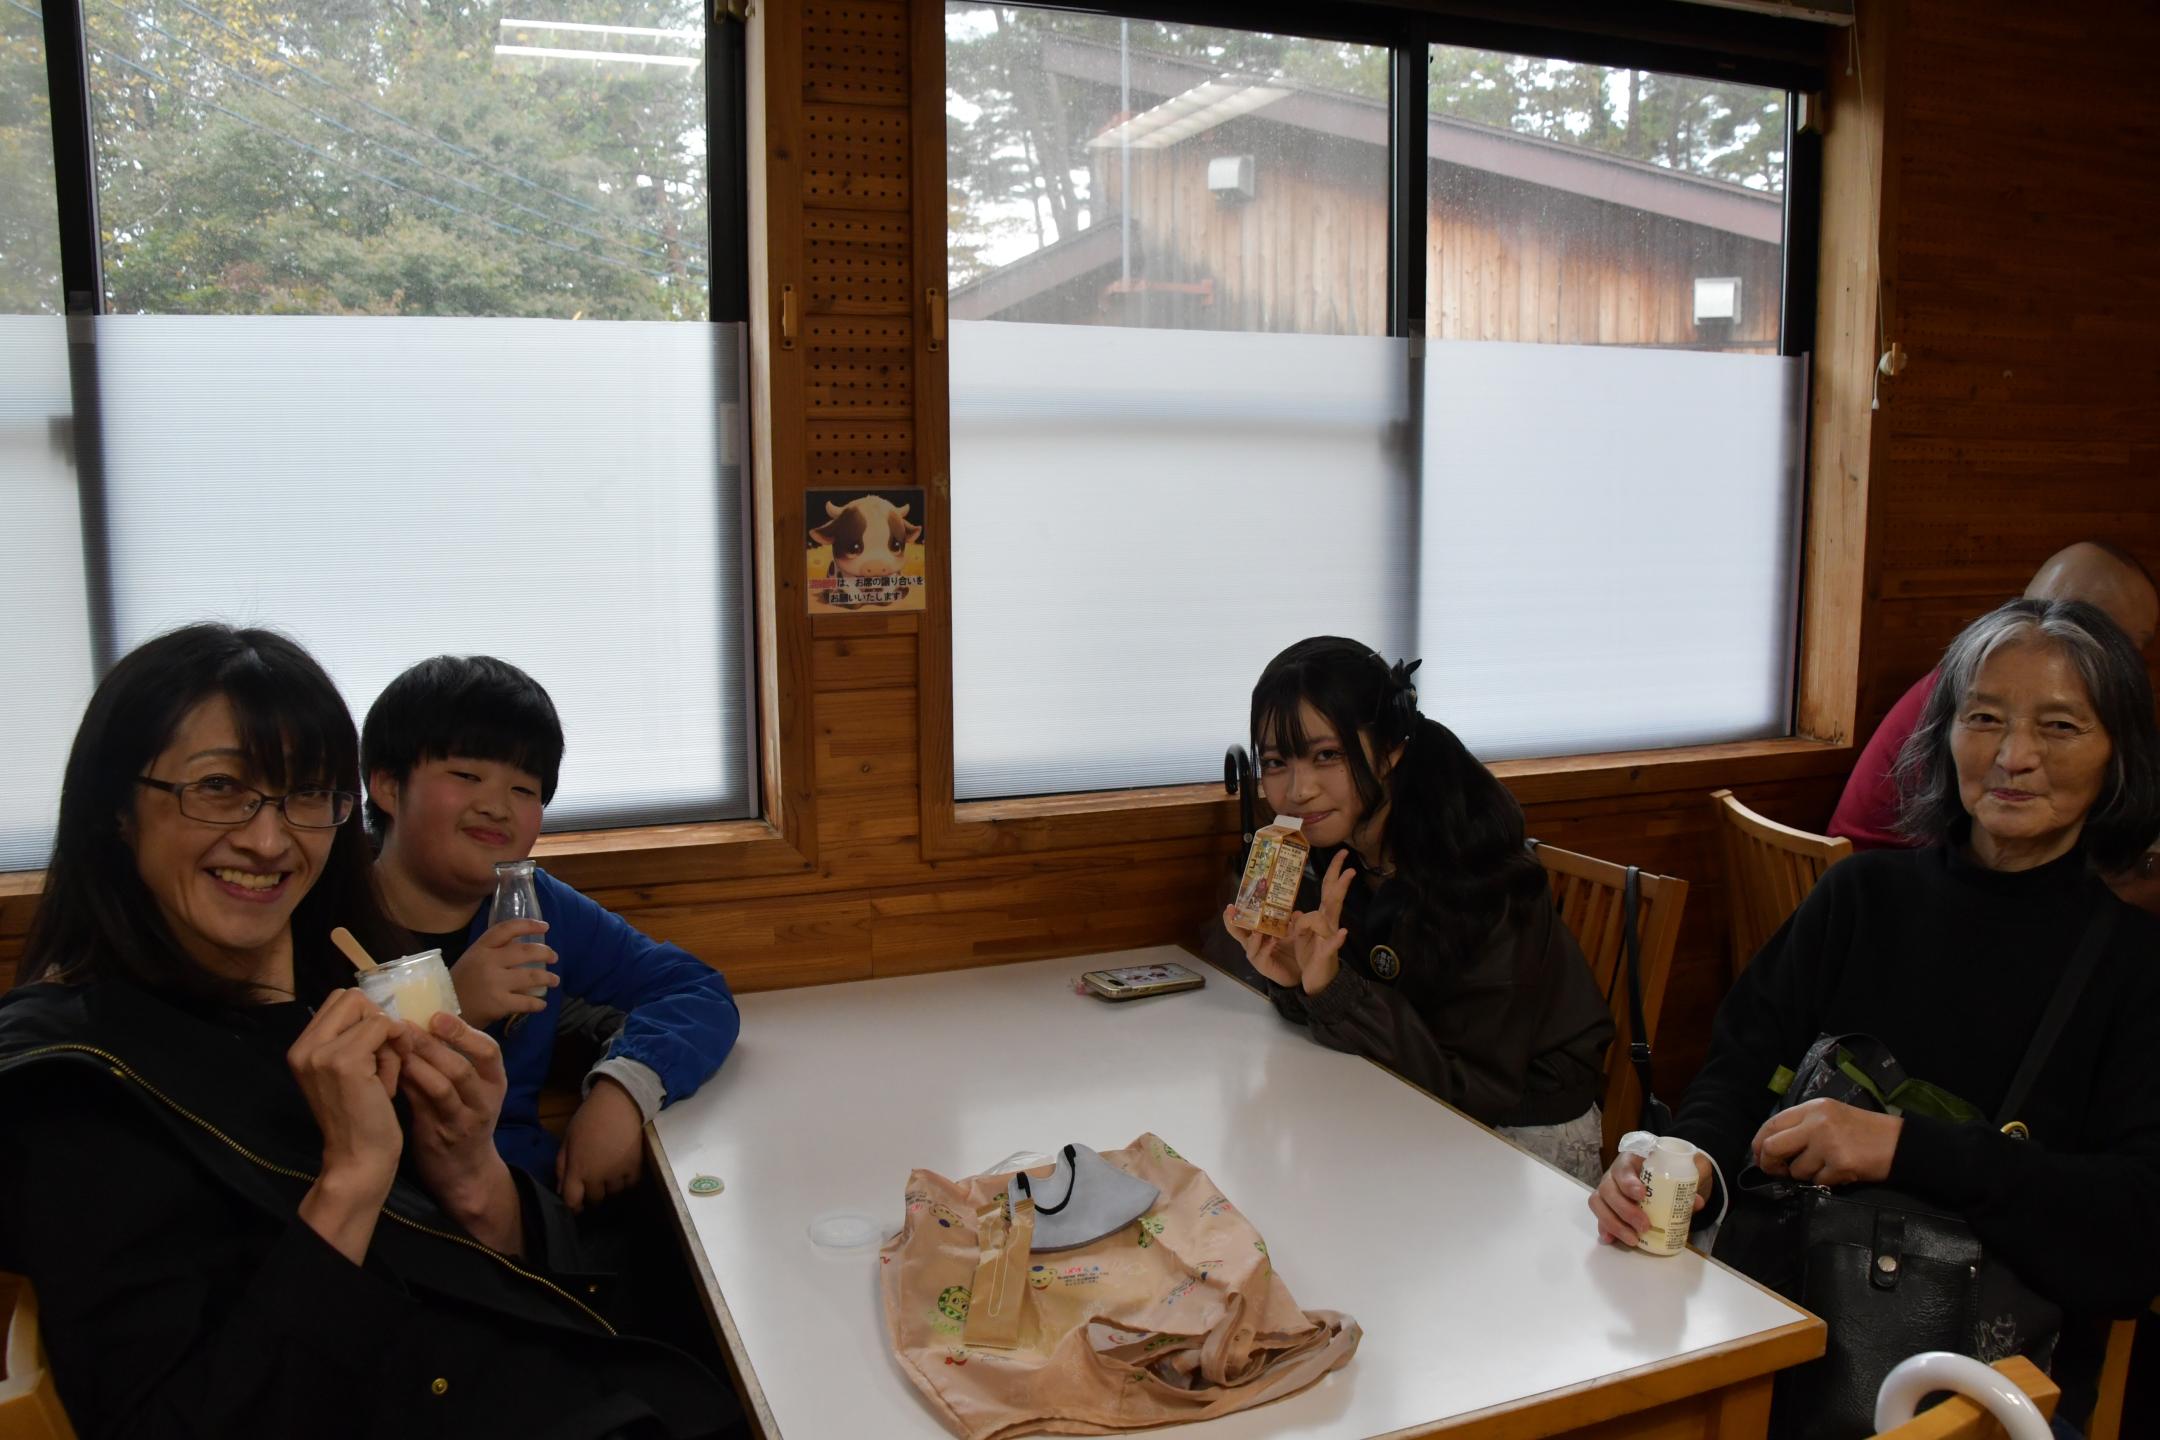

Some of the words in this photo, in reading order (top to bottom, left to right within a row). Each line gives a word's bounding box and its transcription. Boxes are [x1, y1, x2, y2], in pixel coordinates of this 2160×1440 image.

[809, 576, 924, 588] は、お席の譲り合いを
[831, 592, 900, 603] おいいたします
